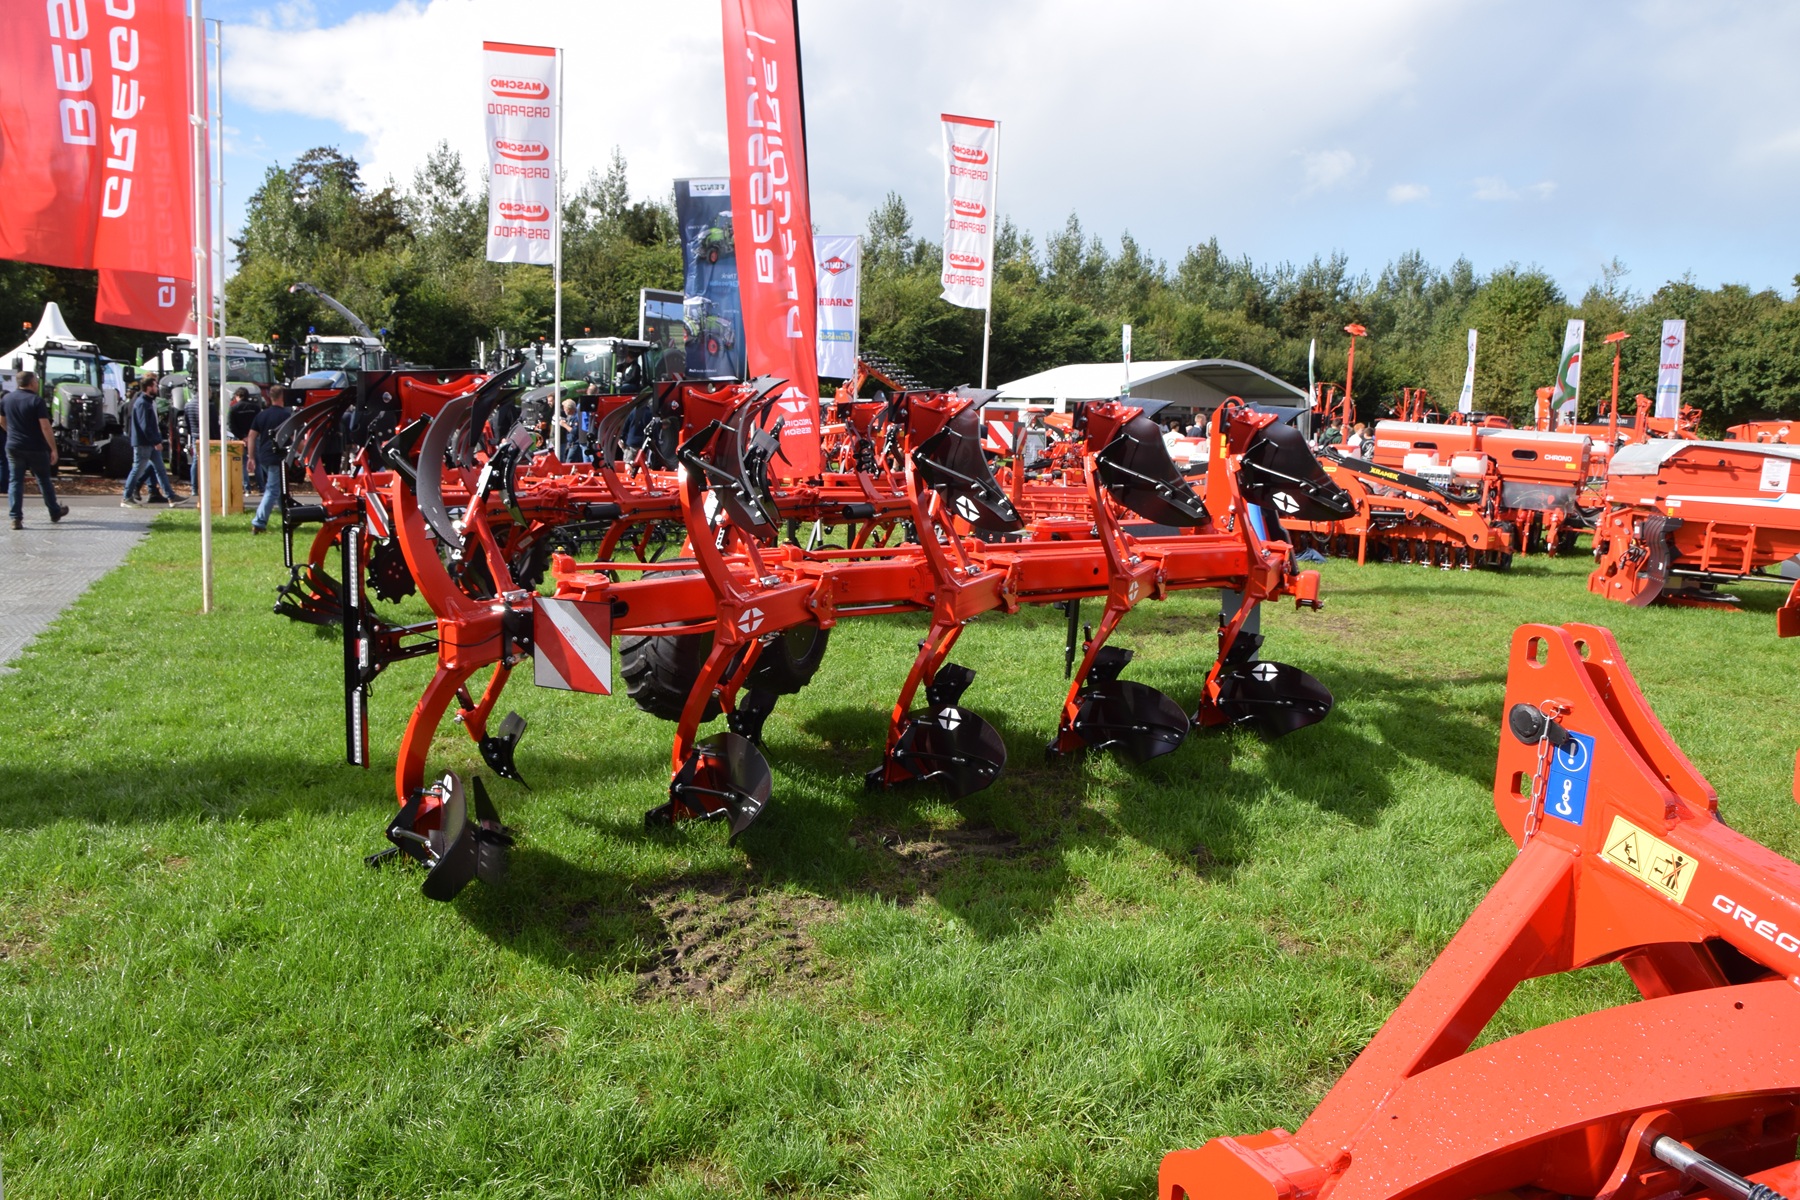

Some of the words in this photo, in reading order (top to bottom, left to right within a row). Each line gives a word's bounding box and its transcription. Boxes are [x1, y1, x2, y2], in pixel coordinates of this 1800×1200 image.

[1544, 453, 1573, 463] CHRONO
[1369, 466, 1400, 481] KRAMER
[1712, 894, 1800, 958] GRÉG
